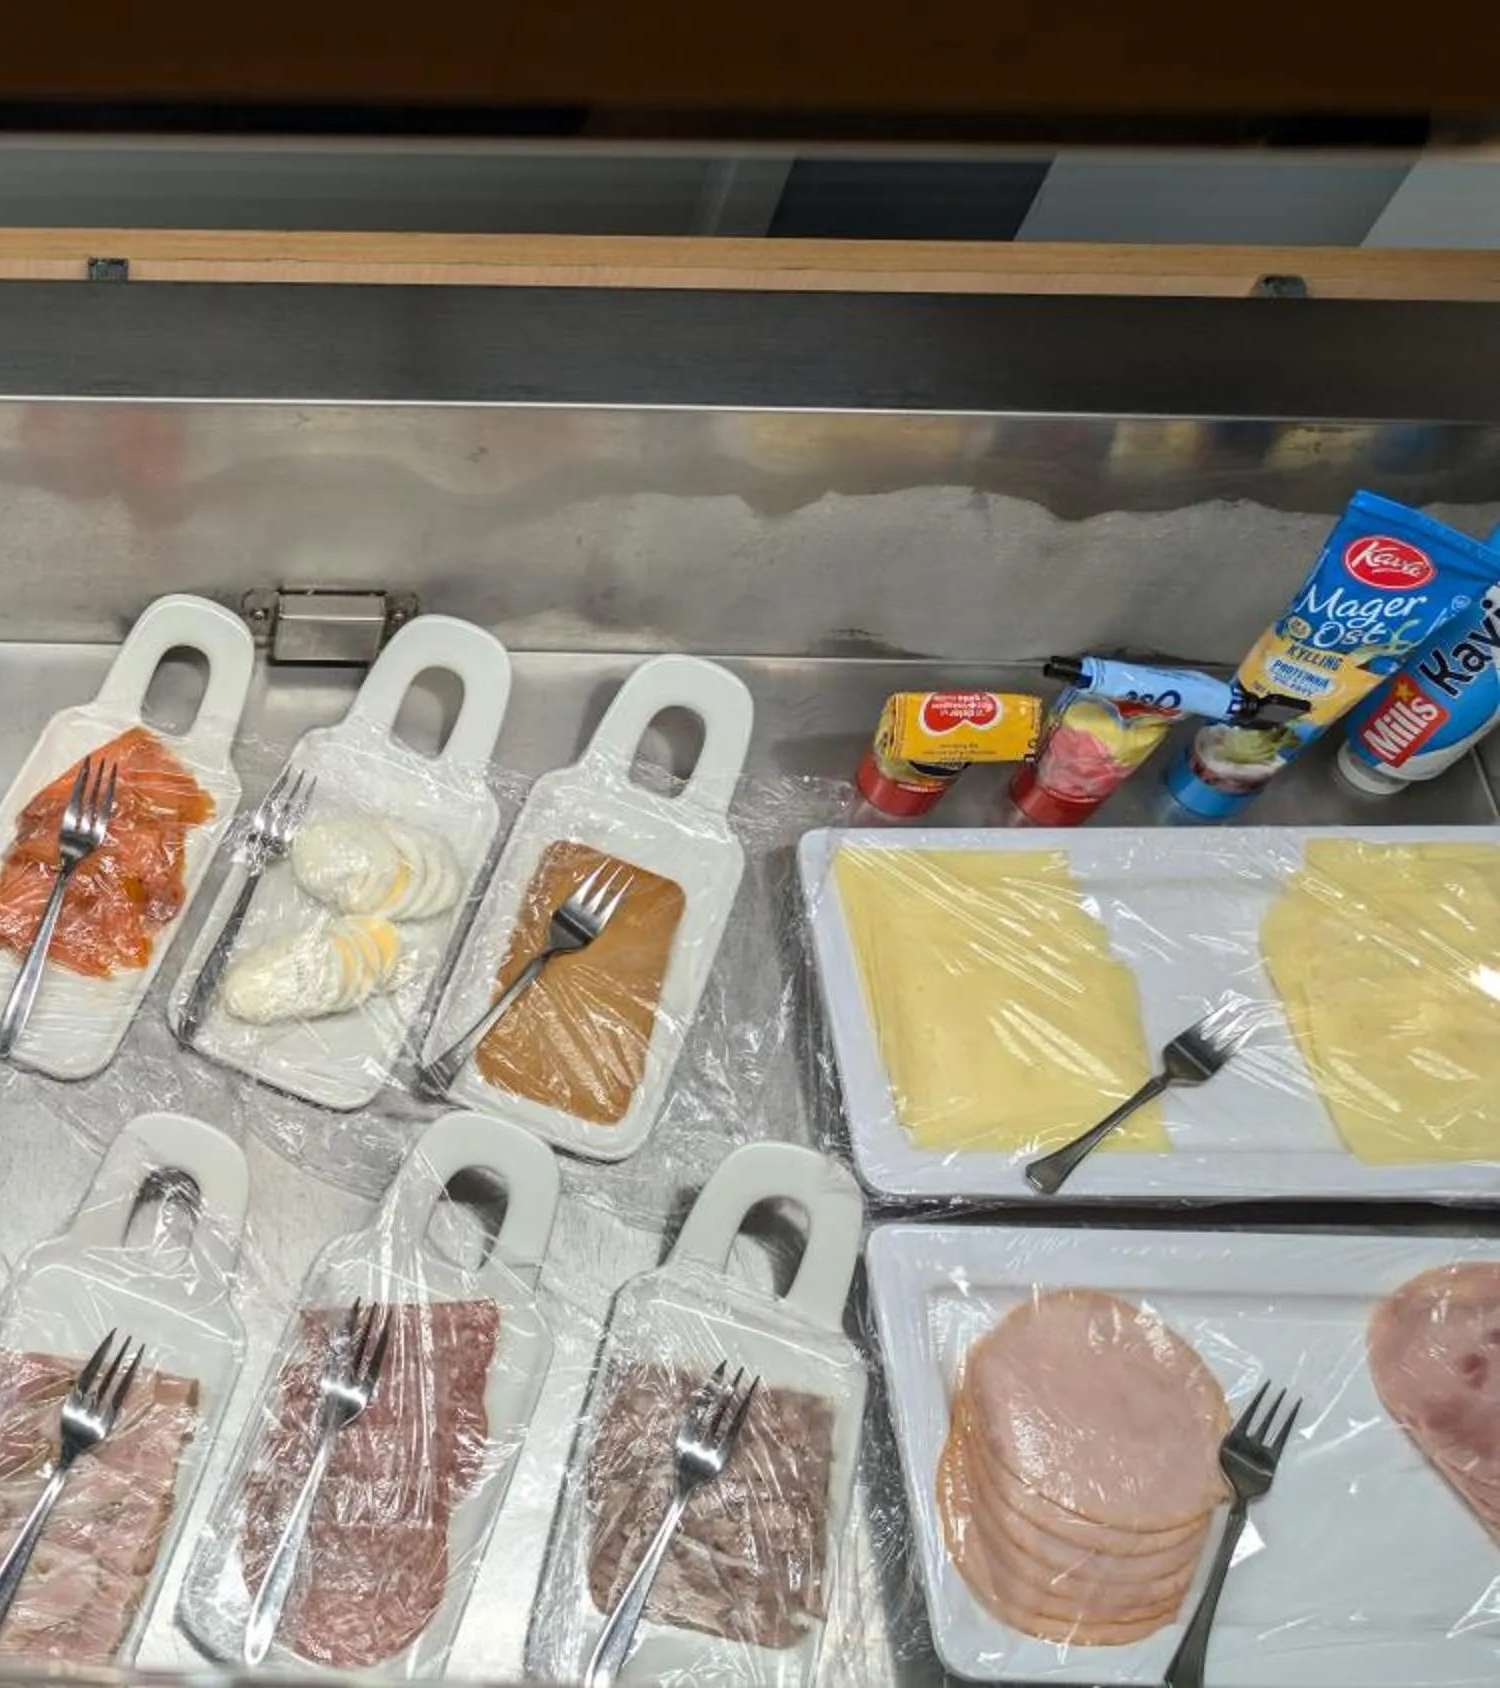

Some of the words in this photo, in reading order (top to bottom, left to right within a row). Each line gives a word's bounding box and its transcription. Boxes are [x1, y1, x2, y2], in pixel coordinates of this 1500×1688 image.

[1296, 583, 1428, 628] Mager
[1313, 620, 1387, 648] Ost
[1286, 643, 1344, 671] KYLLING
[1363, 696, 1440, 761] Mills
